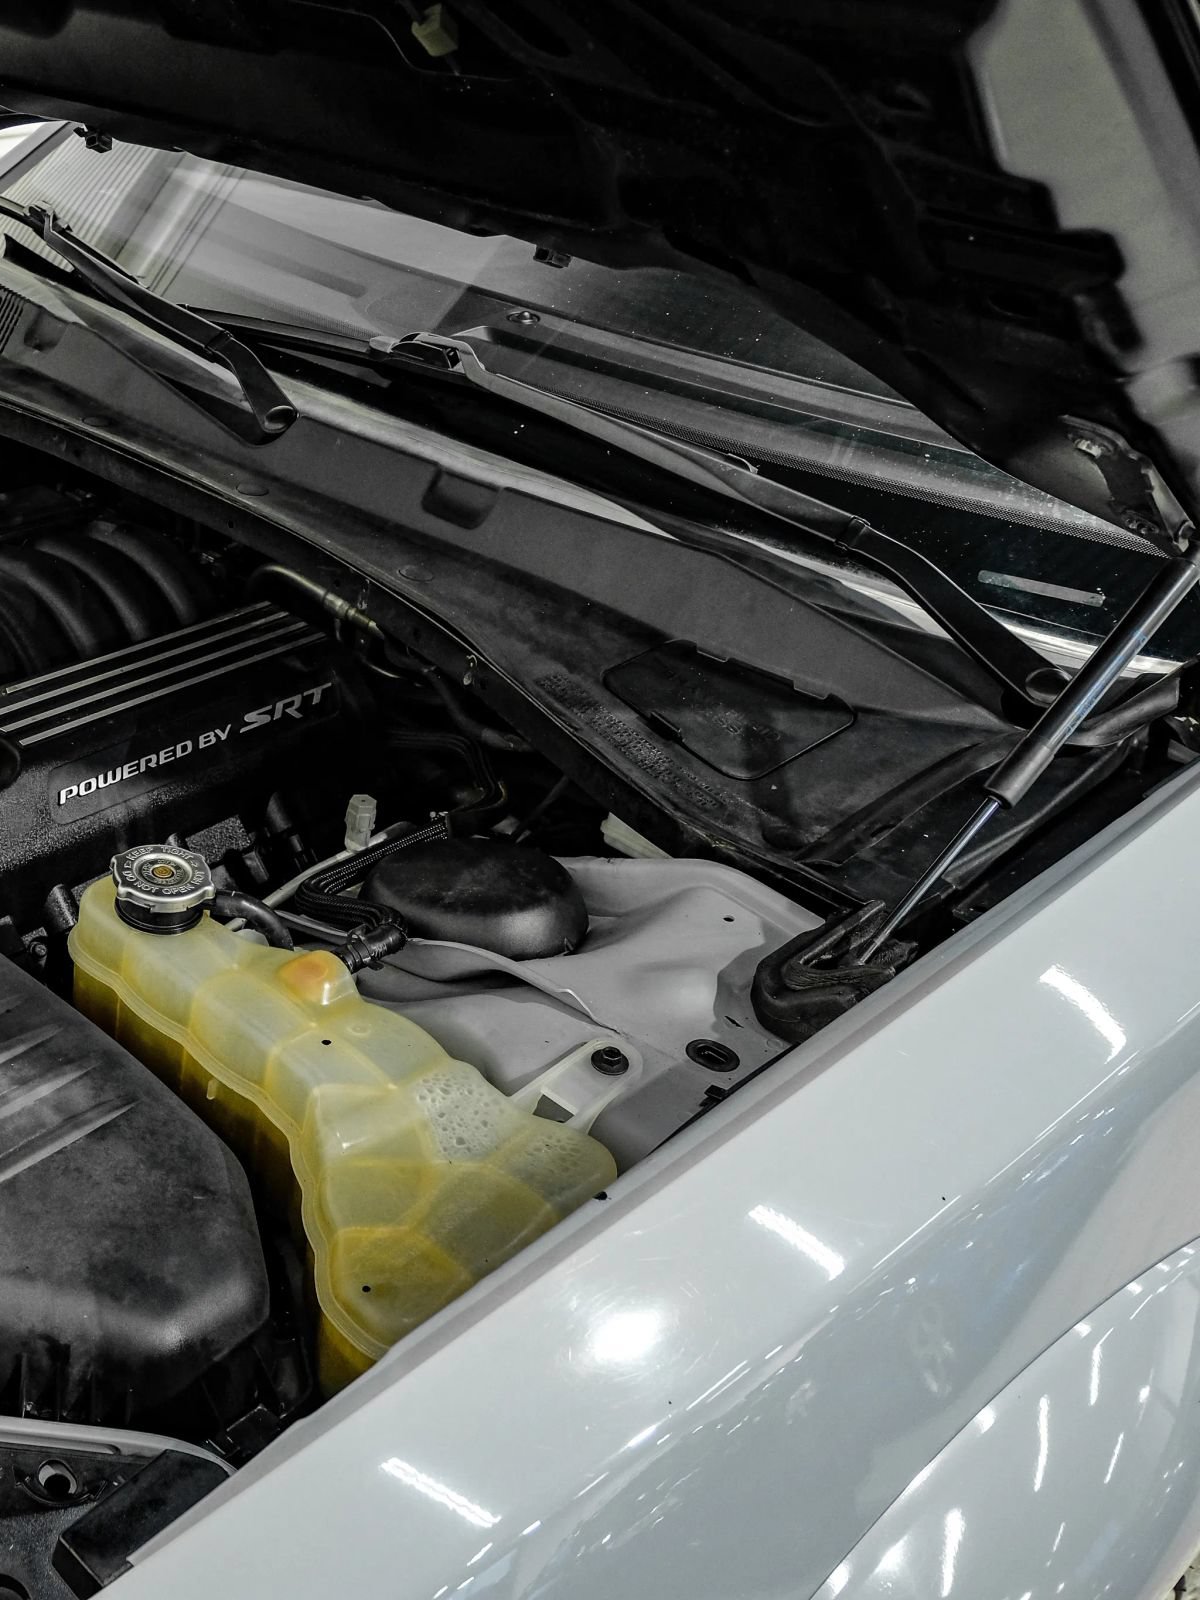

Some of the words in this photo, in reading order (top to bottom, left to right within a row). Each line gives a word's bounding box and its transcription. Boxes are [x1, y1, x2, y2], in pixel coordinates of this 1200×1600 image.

[58, 739, 194, 805] POWERED
[198, 723, 232, 750] BY
[240, 682, 332, 734] SRT
[126, 847, 153, 860] KEEP
[161, 846, 194, 860] TIGHT
[122, 870, 136, 882] DO
[134, 881, 160, 894] NOT
[162, 883, 195, 895] OPEN
